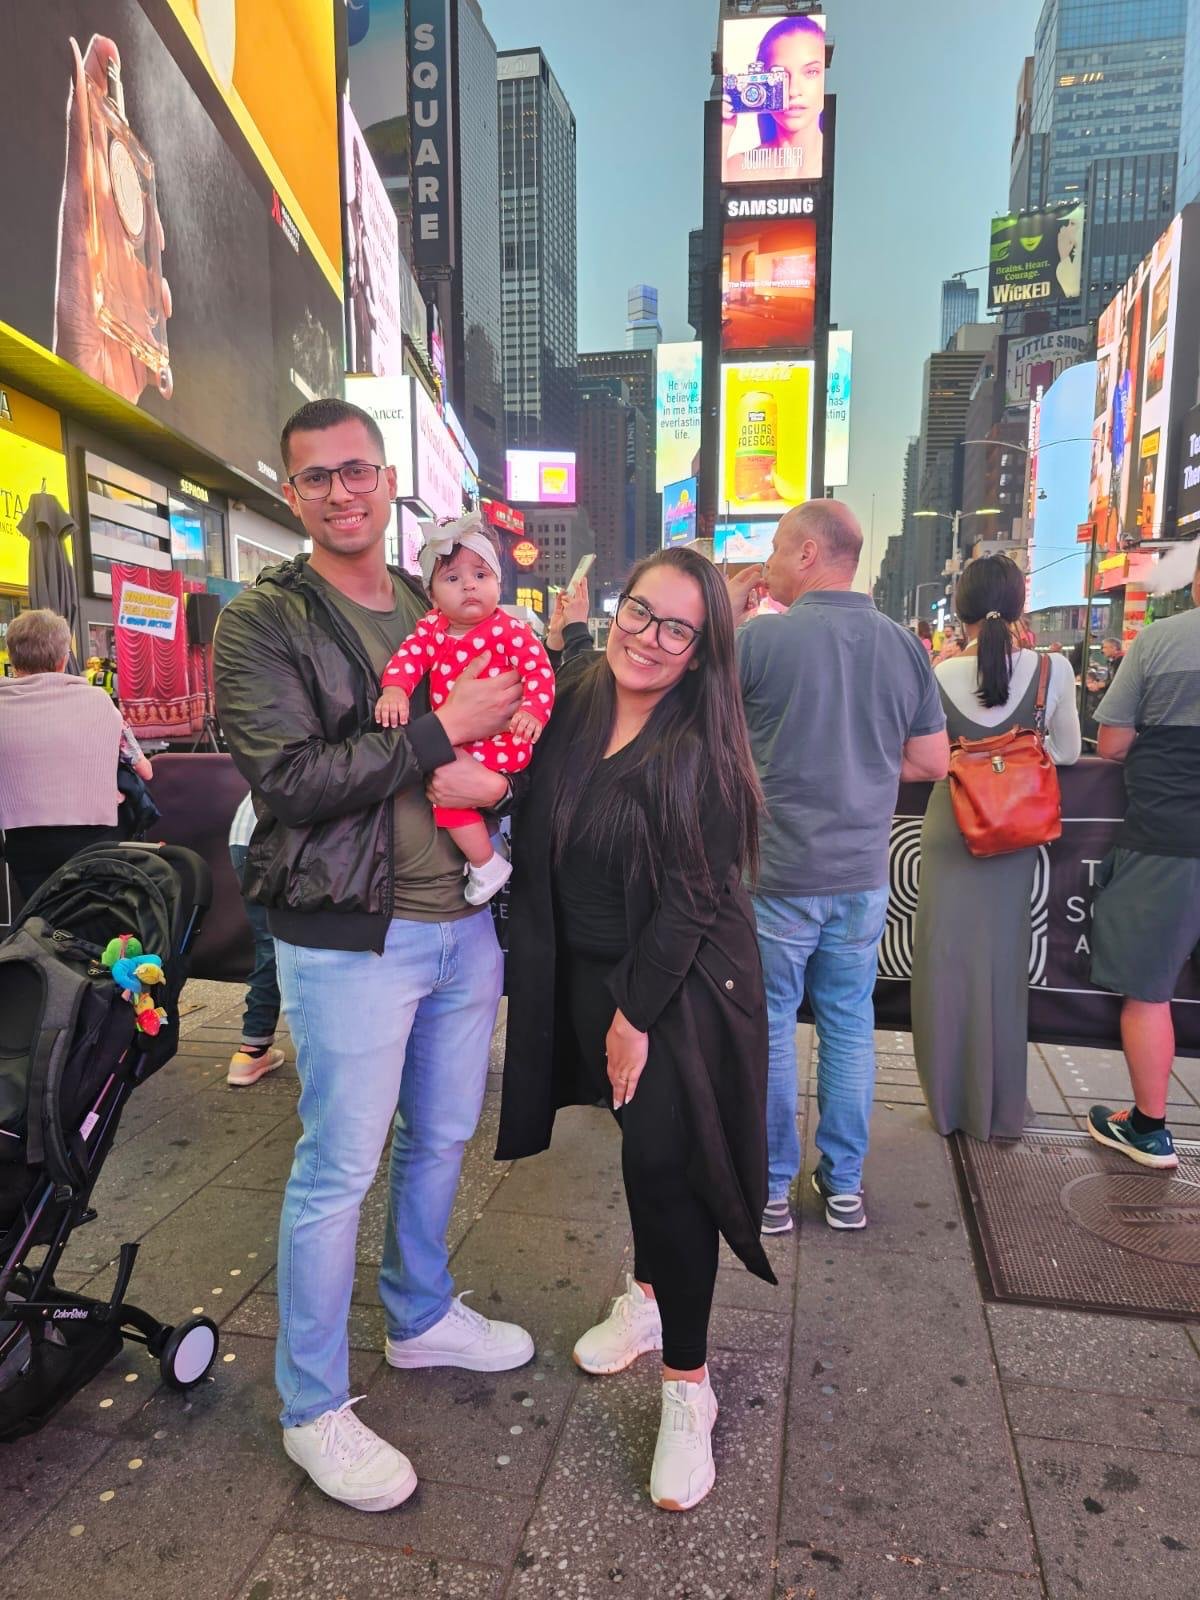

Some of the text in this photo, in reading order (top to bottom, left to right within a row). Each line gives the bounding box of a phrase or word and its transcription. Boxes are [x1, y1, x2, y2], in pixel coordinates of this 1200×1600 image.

[413, 23, 441, 240] SQUARE
[727, 197, 814, 217] SAMSUNG
[1025, 260, 1051, 271] Heart.
[1005, 271, 1040, 280] Courage.
[1016, 335, 1054, 361] LITTLE
[668, 380, 698, 391] He who
[667, 392, 700, 403] believes
[664, 406, 671, 416] in
[672, 406, 686, 415] me
[741, 424, 773, 437] AGUAS
[180, 478, 209, 503] SEPHORA
